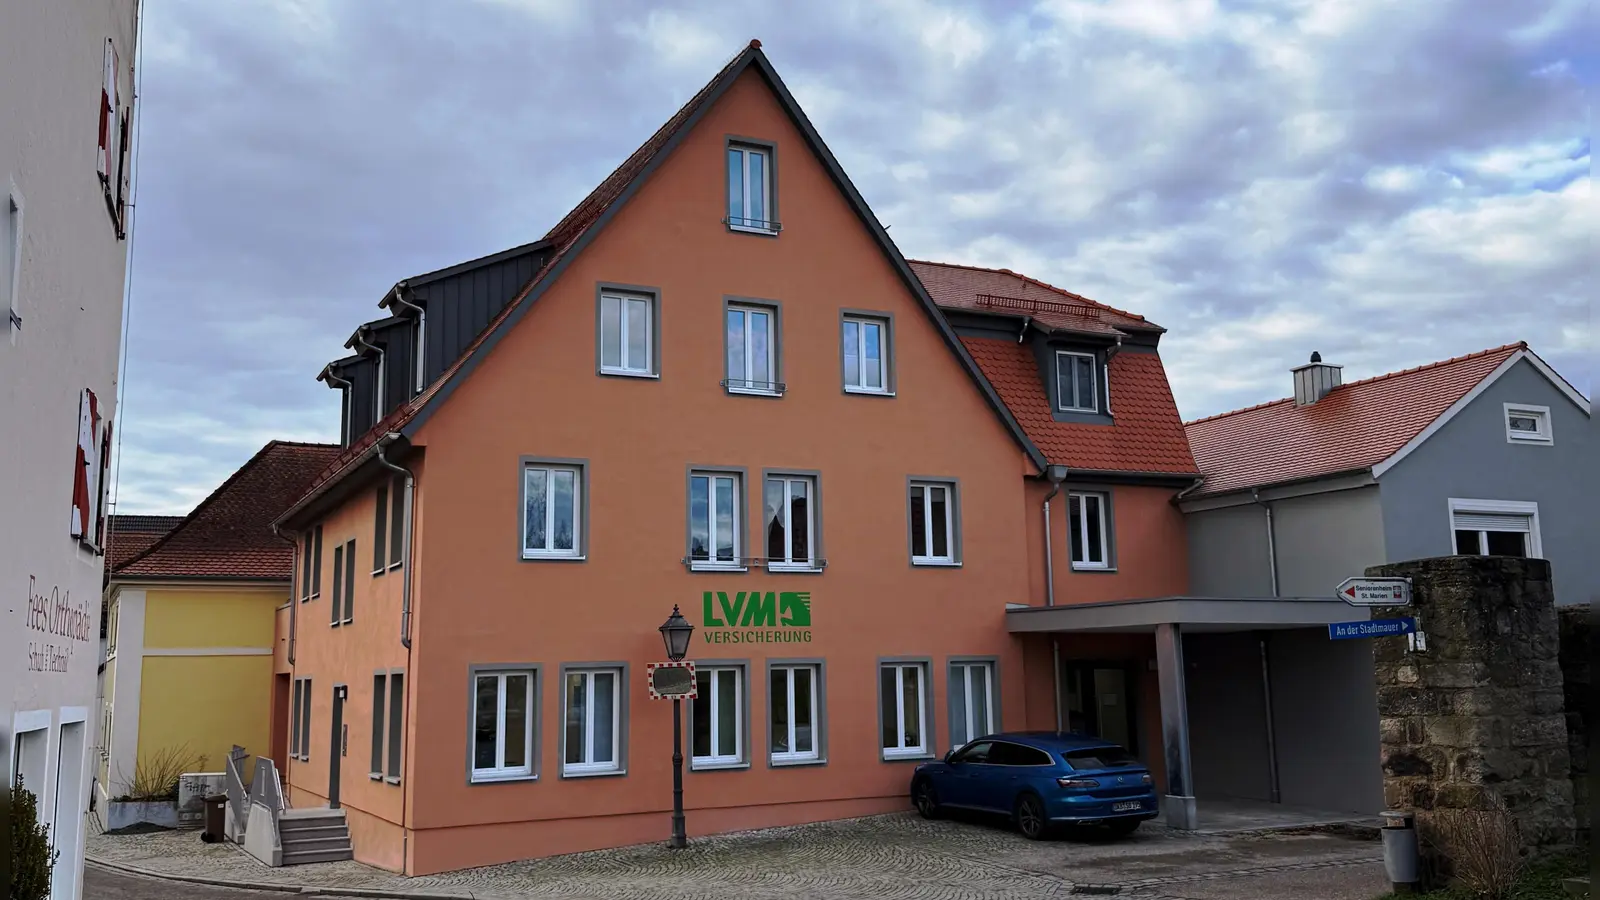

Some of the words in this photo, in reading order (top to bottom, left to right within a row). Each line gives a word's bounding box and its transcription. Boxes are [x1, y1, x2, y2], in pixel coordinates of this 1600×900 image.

[26, 574, 49, 633] Fees
[703, 591, 777, 627] LVM
[704, 630, 812, 644] VERSICHERUNG
[1336, 626, 1346, 636] An
[1347, 625, 1359, 635] der
[1359, 622, 1399, 634] Stadtmauer
